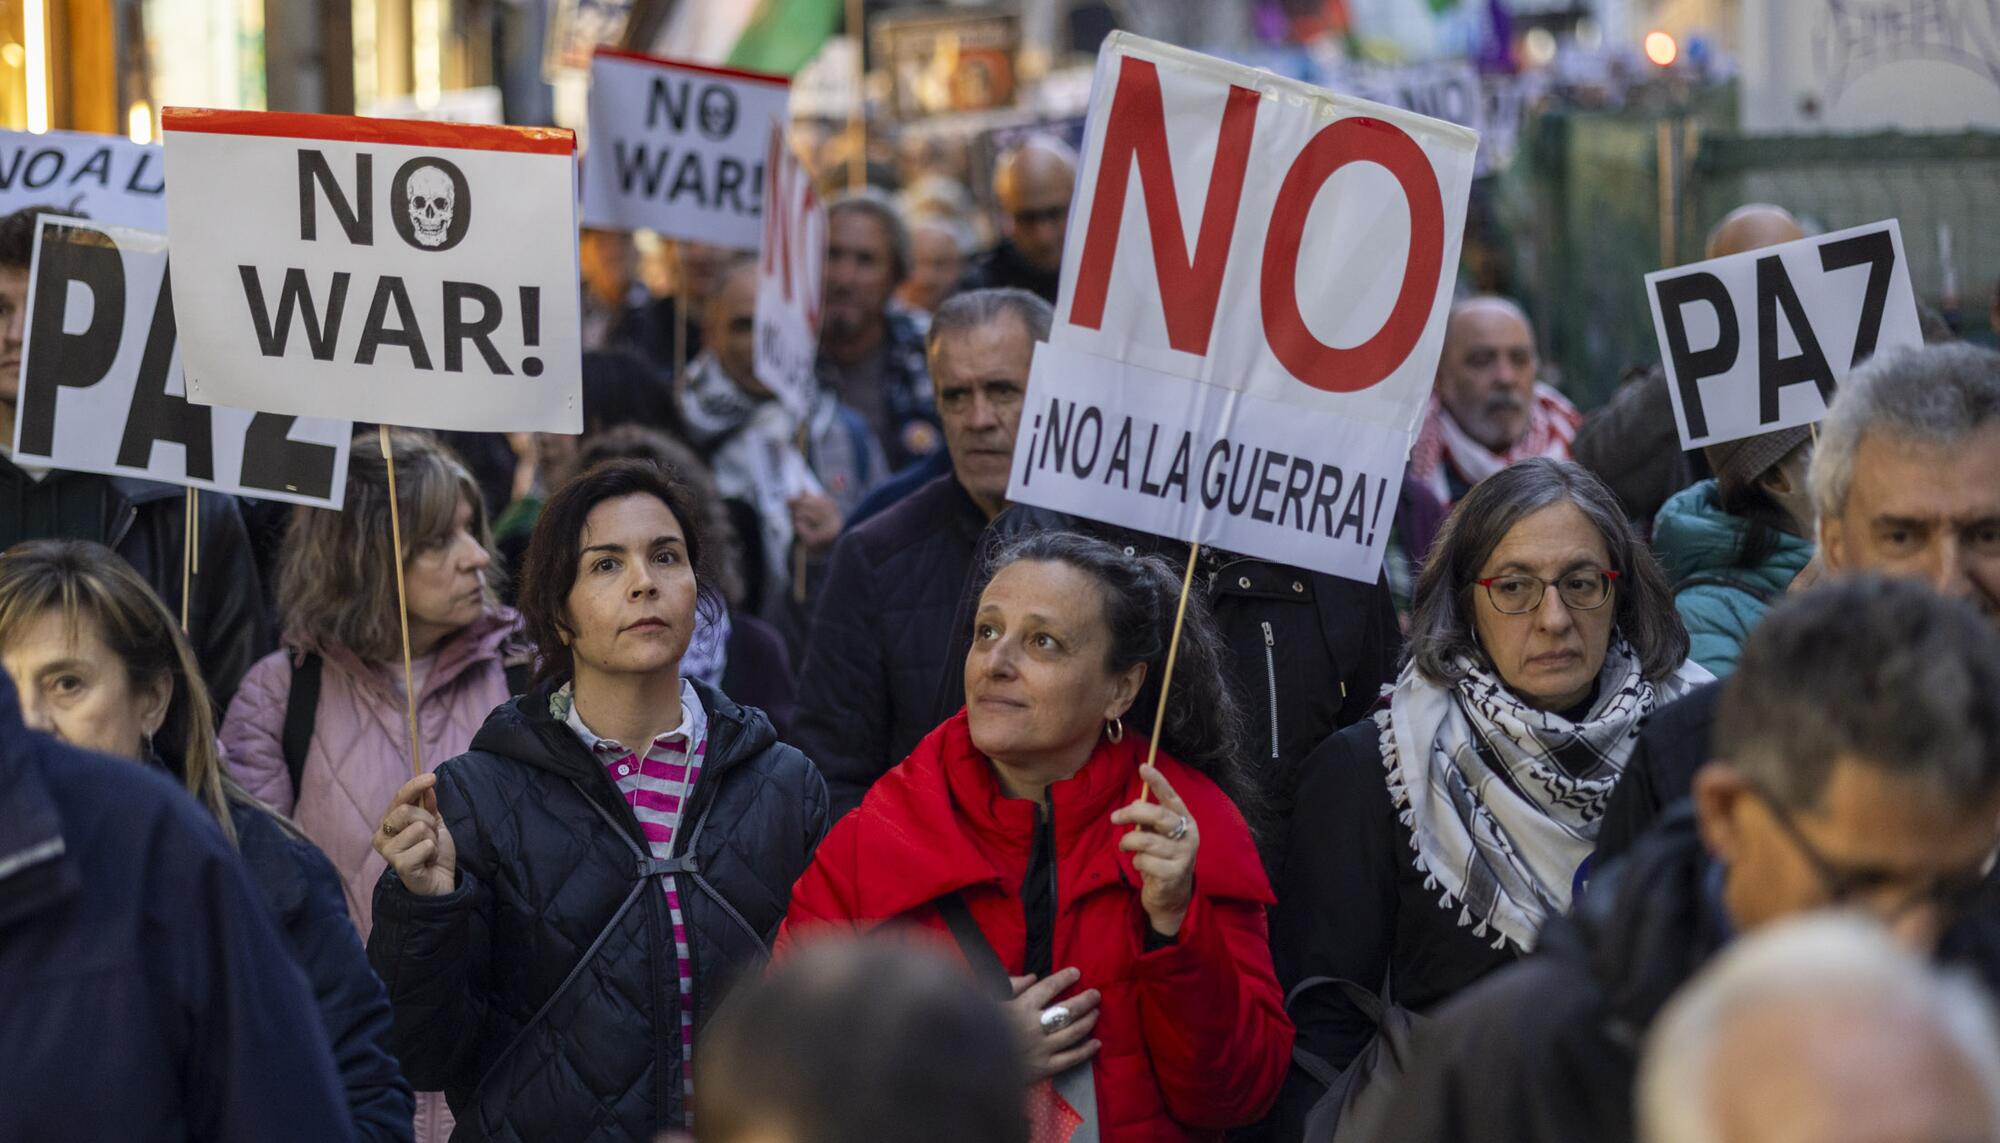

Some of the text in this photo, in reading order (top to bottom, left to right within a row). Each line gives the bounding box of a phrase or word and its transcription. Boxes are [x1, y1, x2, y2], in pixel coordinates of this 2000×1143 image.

[646, 76, 739, 141] NO
[69, 147, 111, 185] A
[126, 154, 165, 195] L
[297, 148, 472, 252] NO
[1069, 55, 1445, 393] NO
[238, 264, 544, 378] WAR!
[1022, 398, 1388, 548] ¡NO A LA GUERRA!
